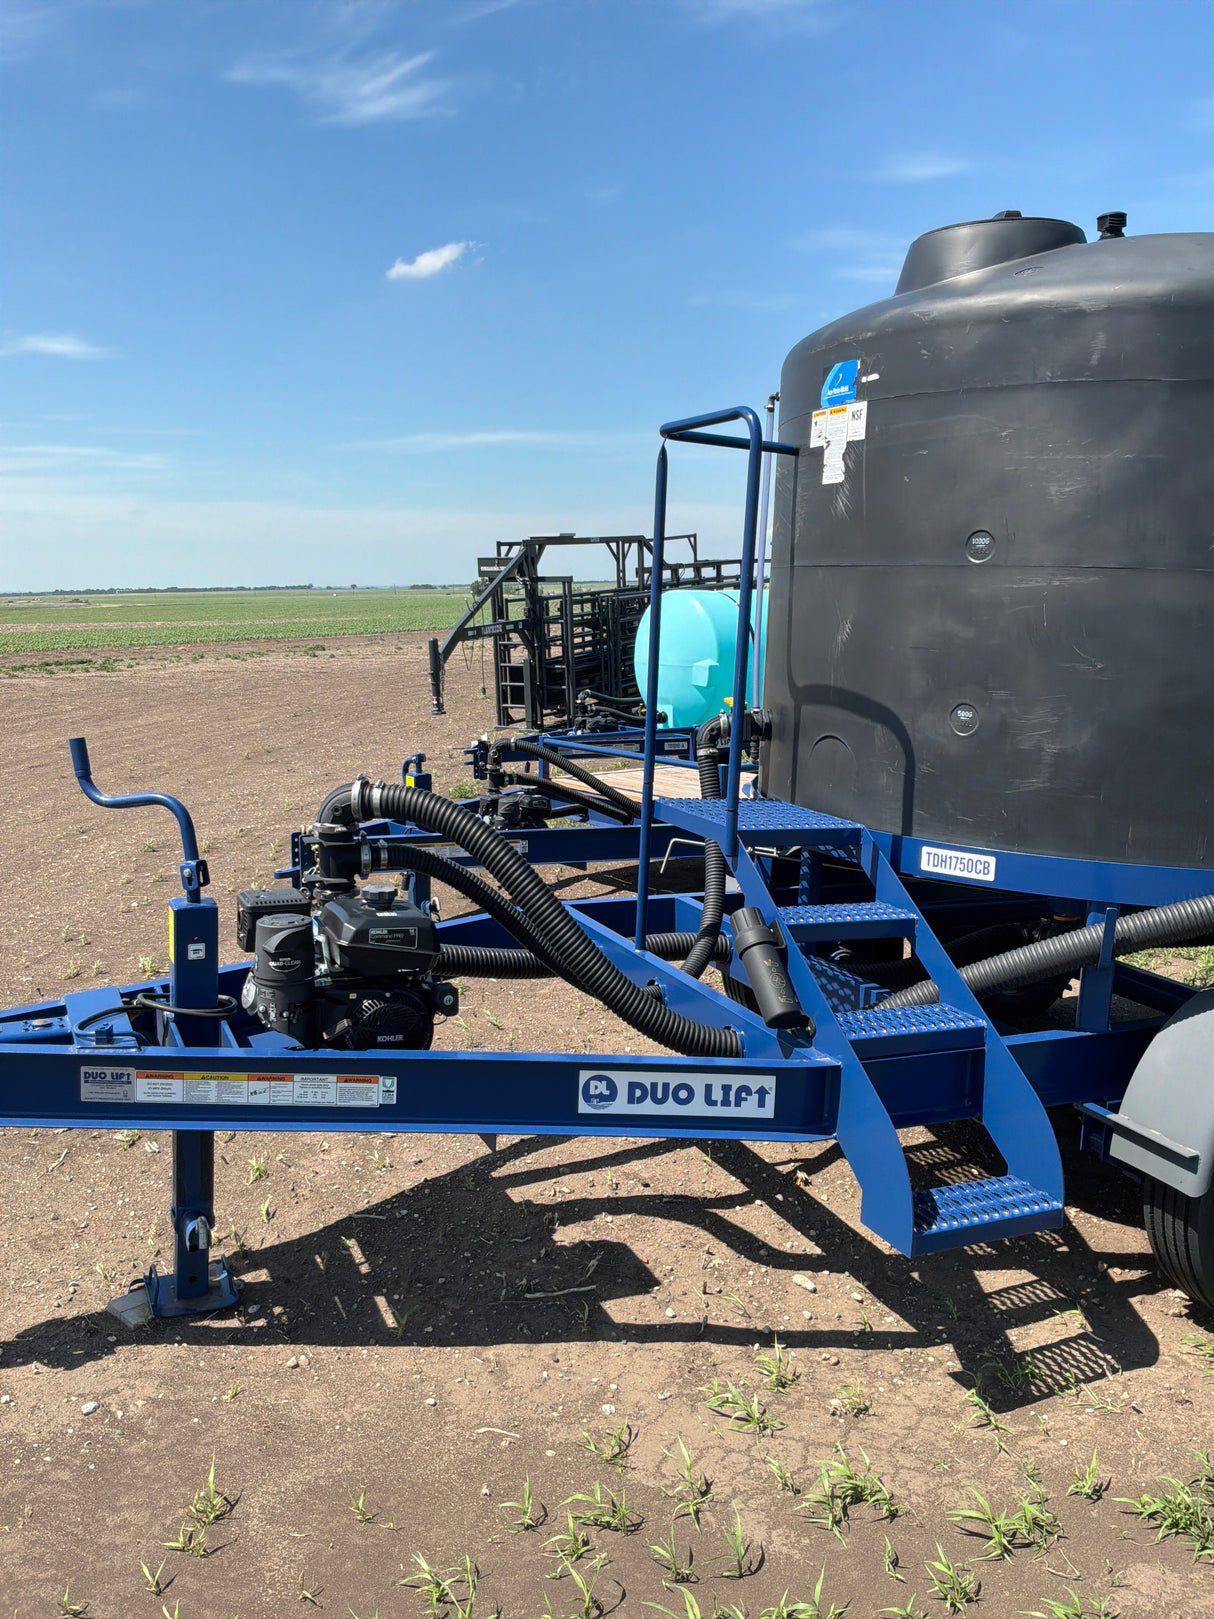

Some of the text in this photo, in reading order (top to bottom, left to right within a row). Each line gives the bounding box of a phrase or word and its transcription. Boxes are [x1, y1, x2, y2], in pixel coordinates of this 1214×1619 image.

[851, 409, 863, 421] NSF
[925, 851, 991, 876] TDH1750CB
[376, 1034, 403, 1043] KOHLER
[83, 1071, 107, 1080] DUO
[626, 1081, 695, 1106] DUO
